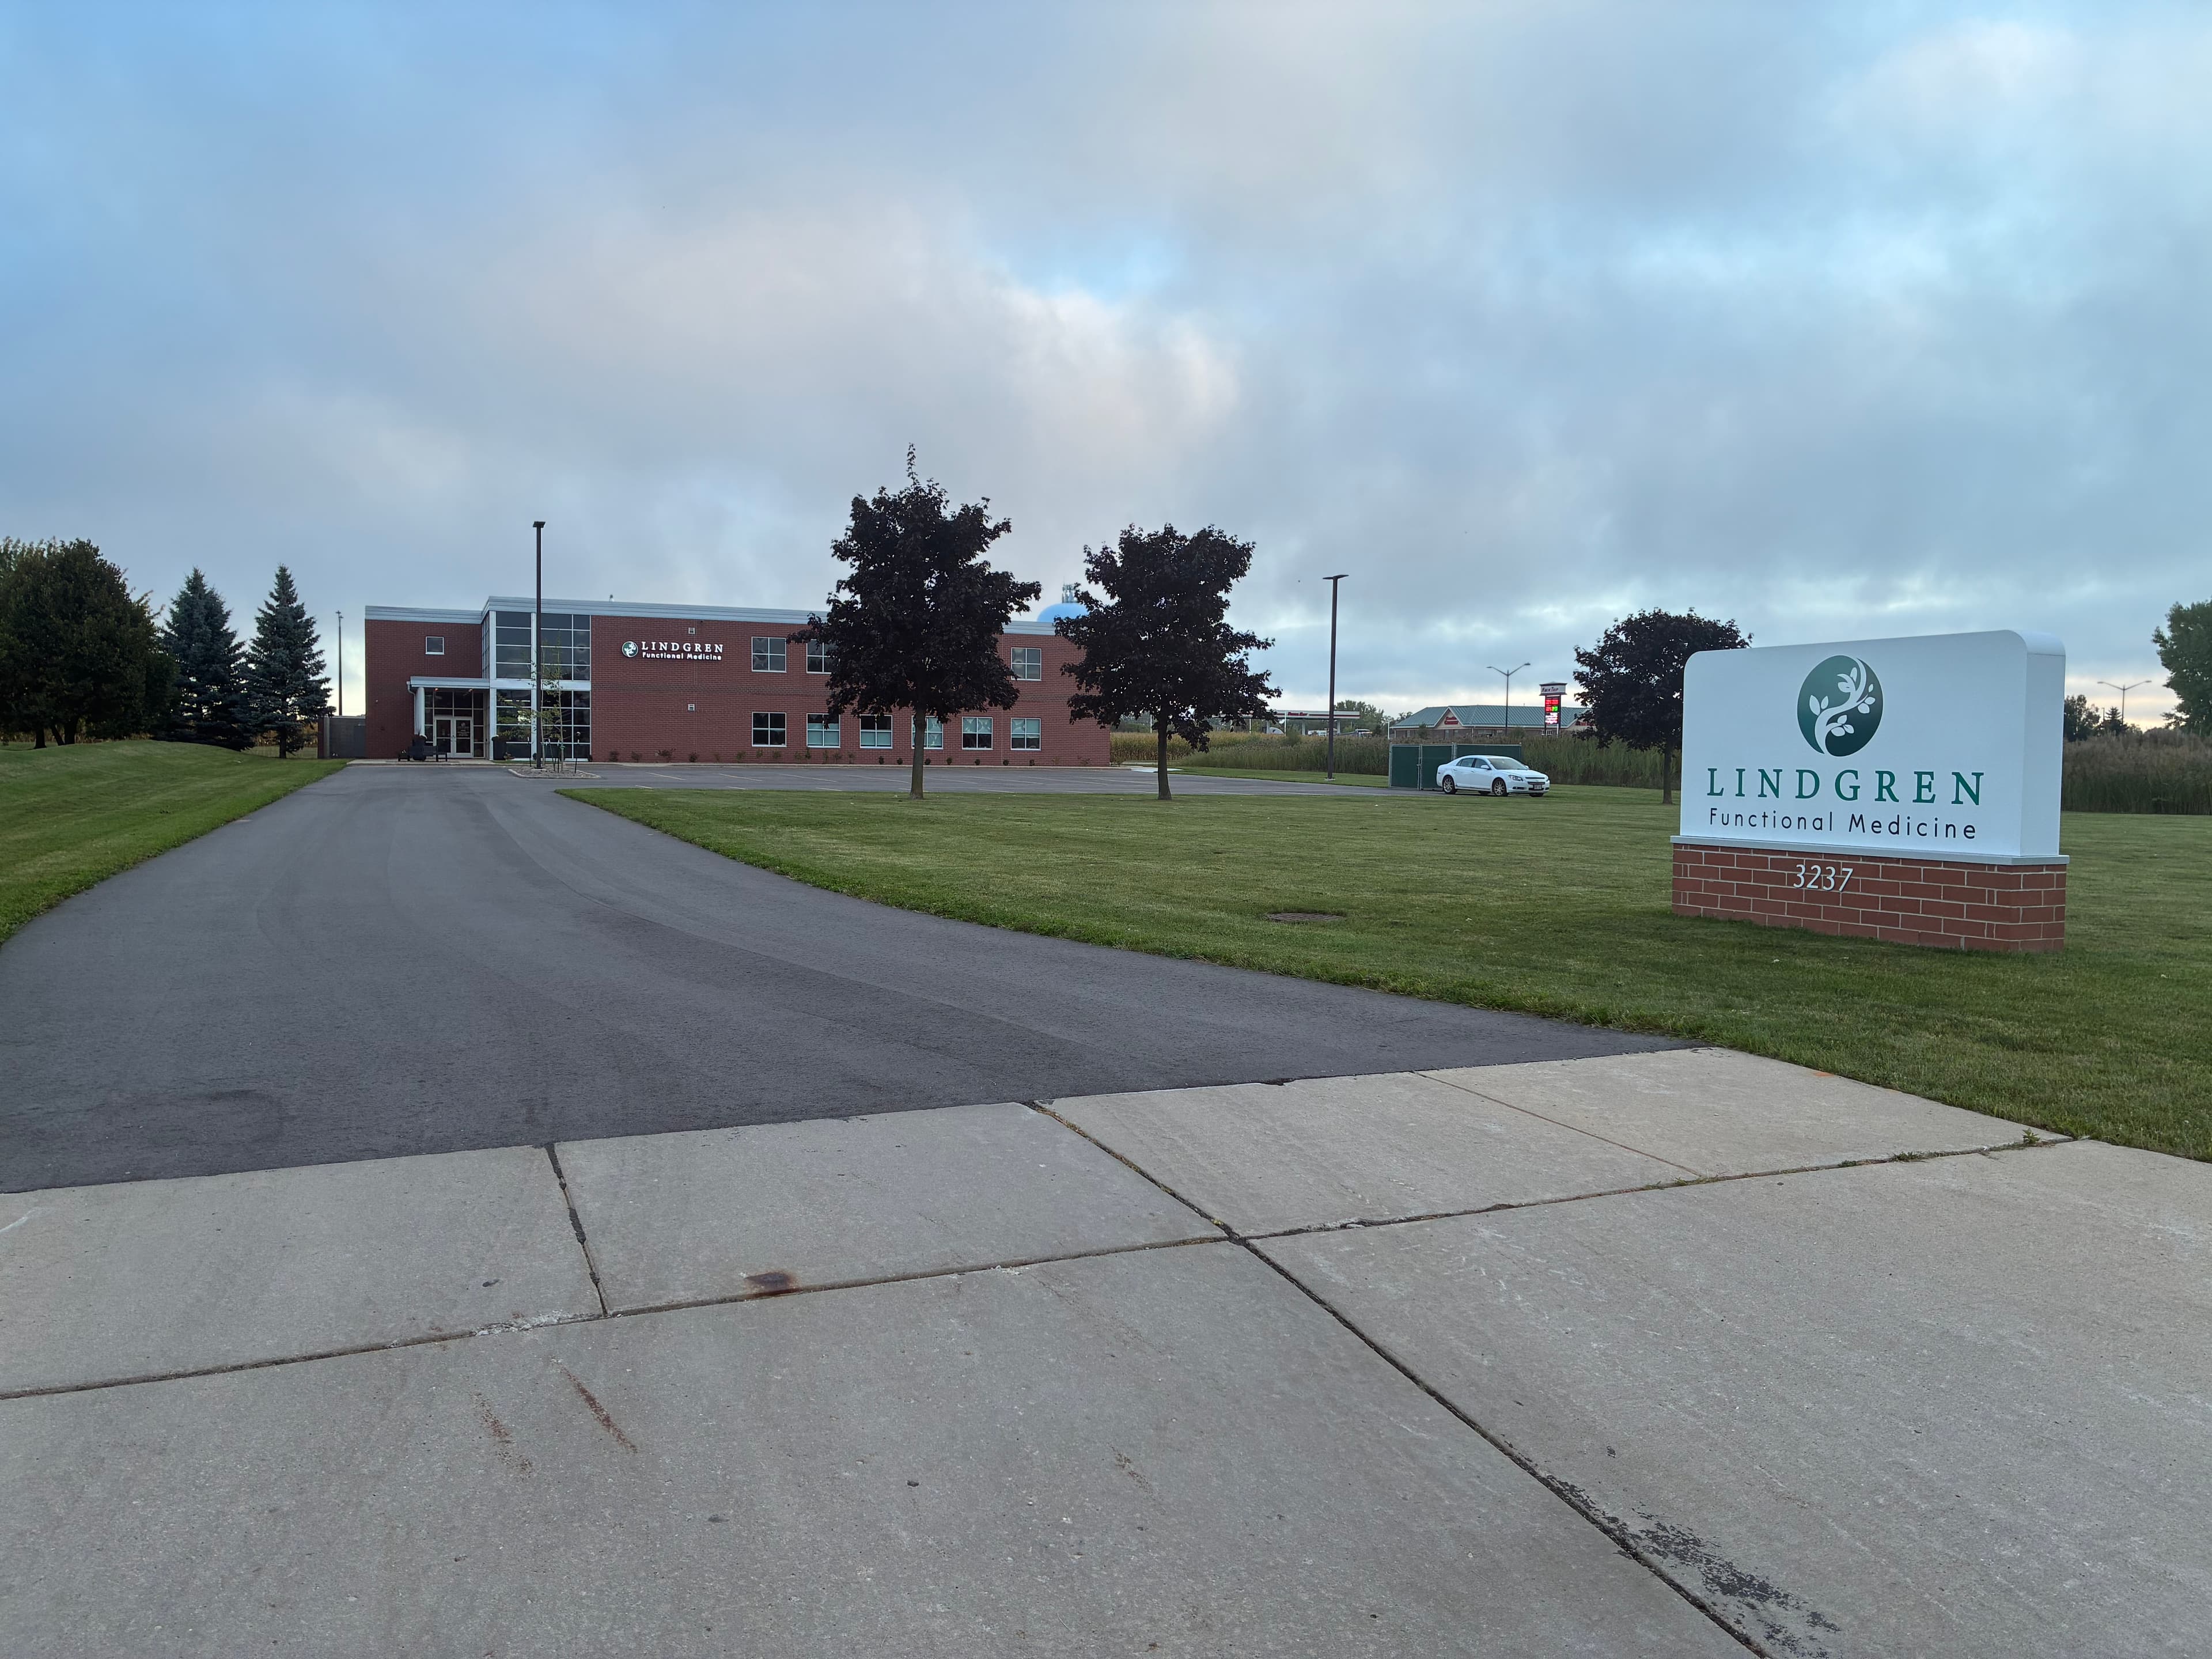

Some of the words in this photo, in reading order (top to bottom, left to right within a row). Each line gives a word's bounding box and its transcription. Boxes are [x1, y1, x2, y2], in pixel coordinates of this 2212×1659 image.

[642, 641, 723, 653] LINDGREN
[1707, 768, 1984, 805] LINDGREN
[1710, 808, 1833, 831] Functional
[1849, 813, 1976, 839] Medicine
[1793, 864, 1854, 892] 3237
